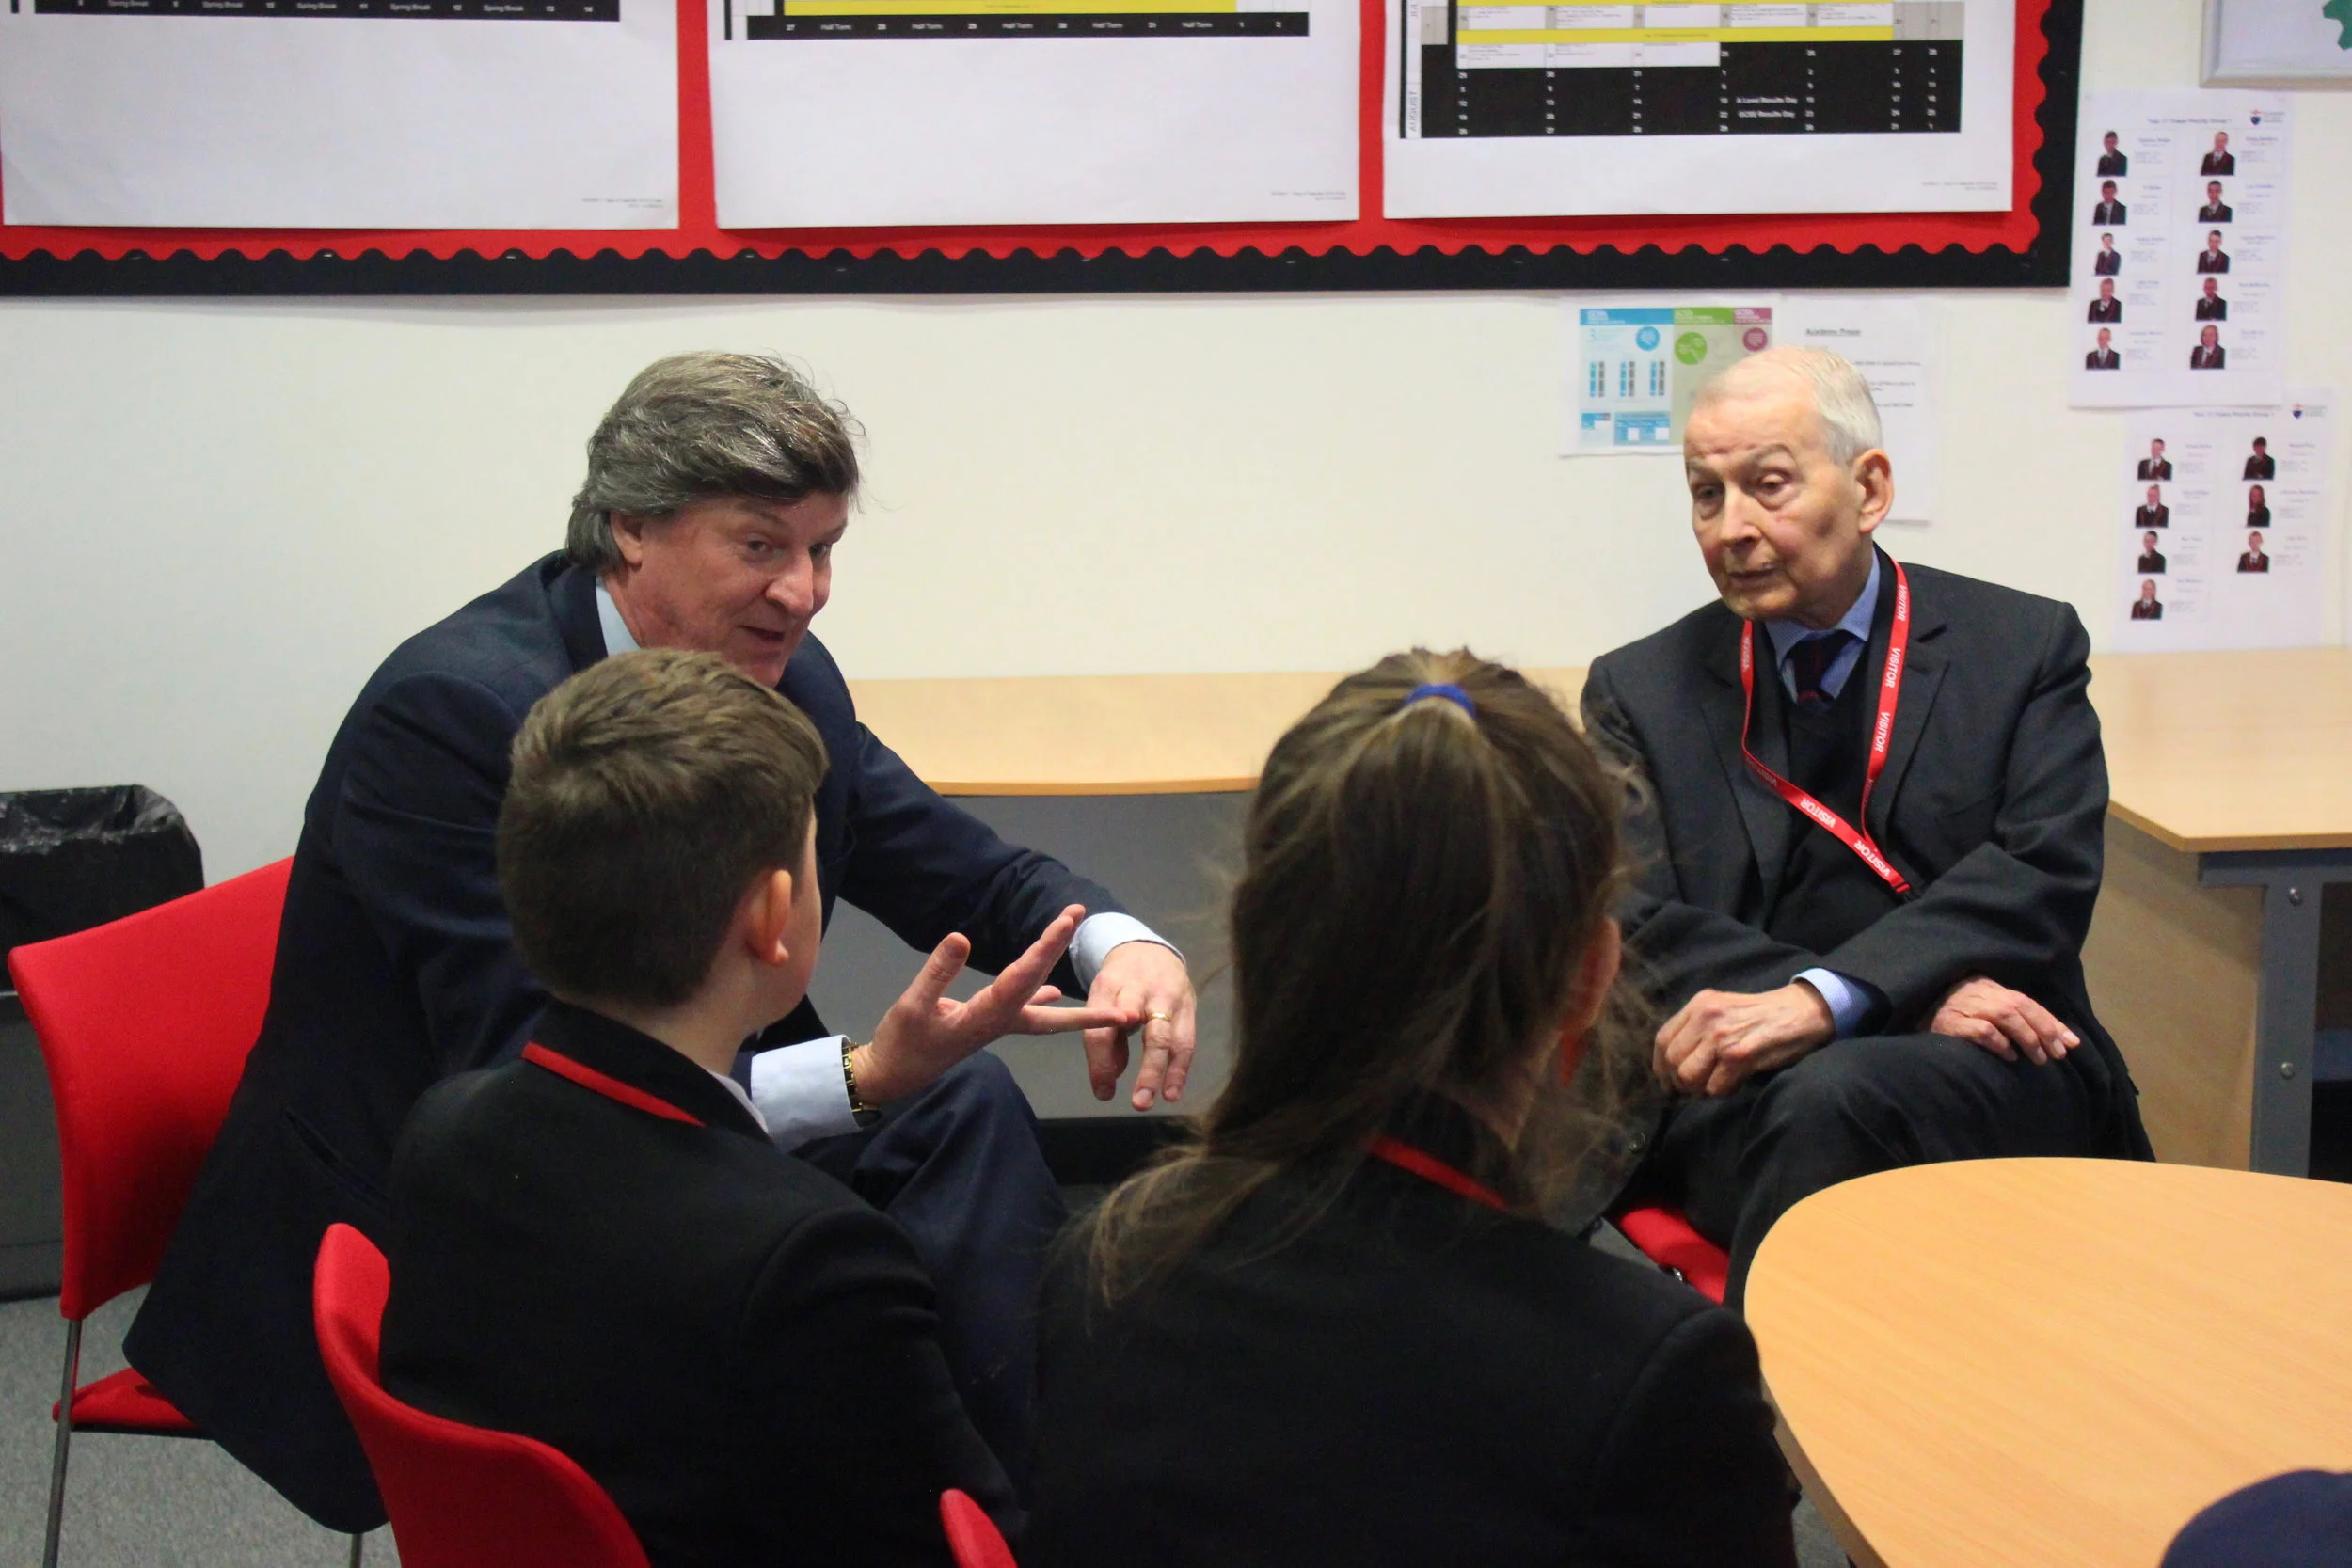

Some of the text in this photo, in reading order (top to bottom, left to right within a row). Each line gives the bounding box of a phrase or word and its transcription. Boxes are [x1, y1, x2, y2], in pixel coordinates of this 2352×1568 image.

[1898, 584, 1908, 622] VISITOR
[1885, 647, 1901, 689] VISITOR
[1875, 711, 1891, 753] VISITOR
[1800, 798, 1836, 829] VISITOR
[1854, 840, 1891, 877] VISITOR
